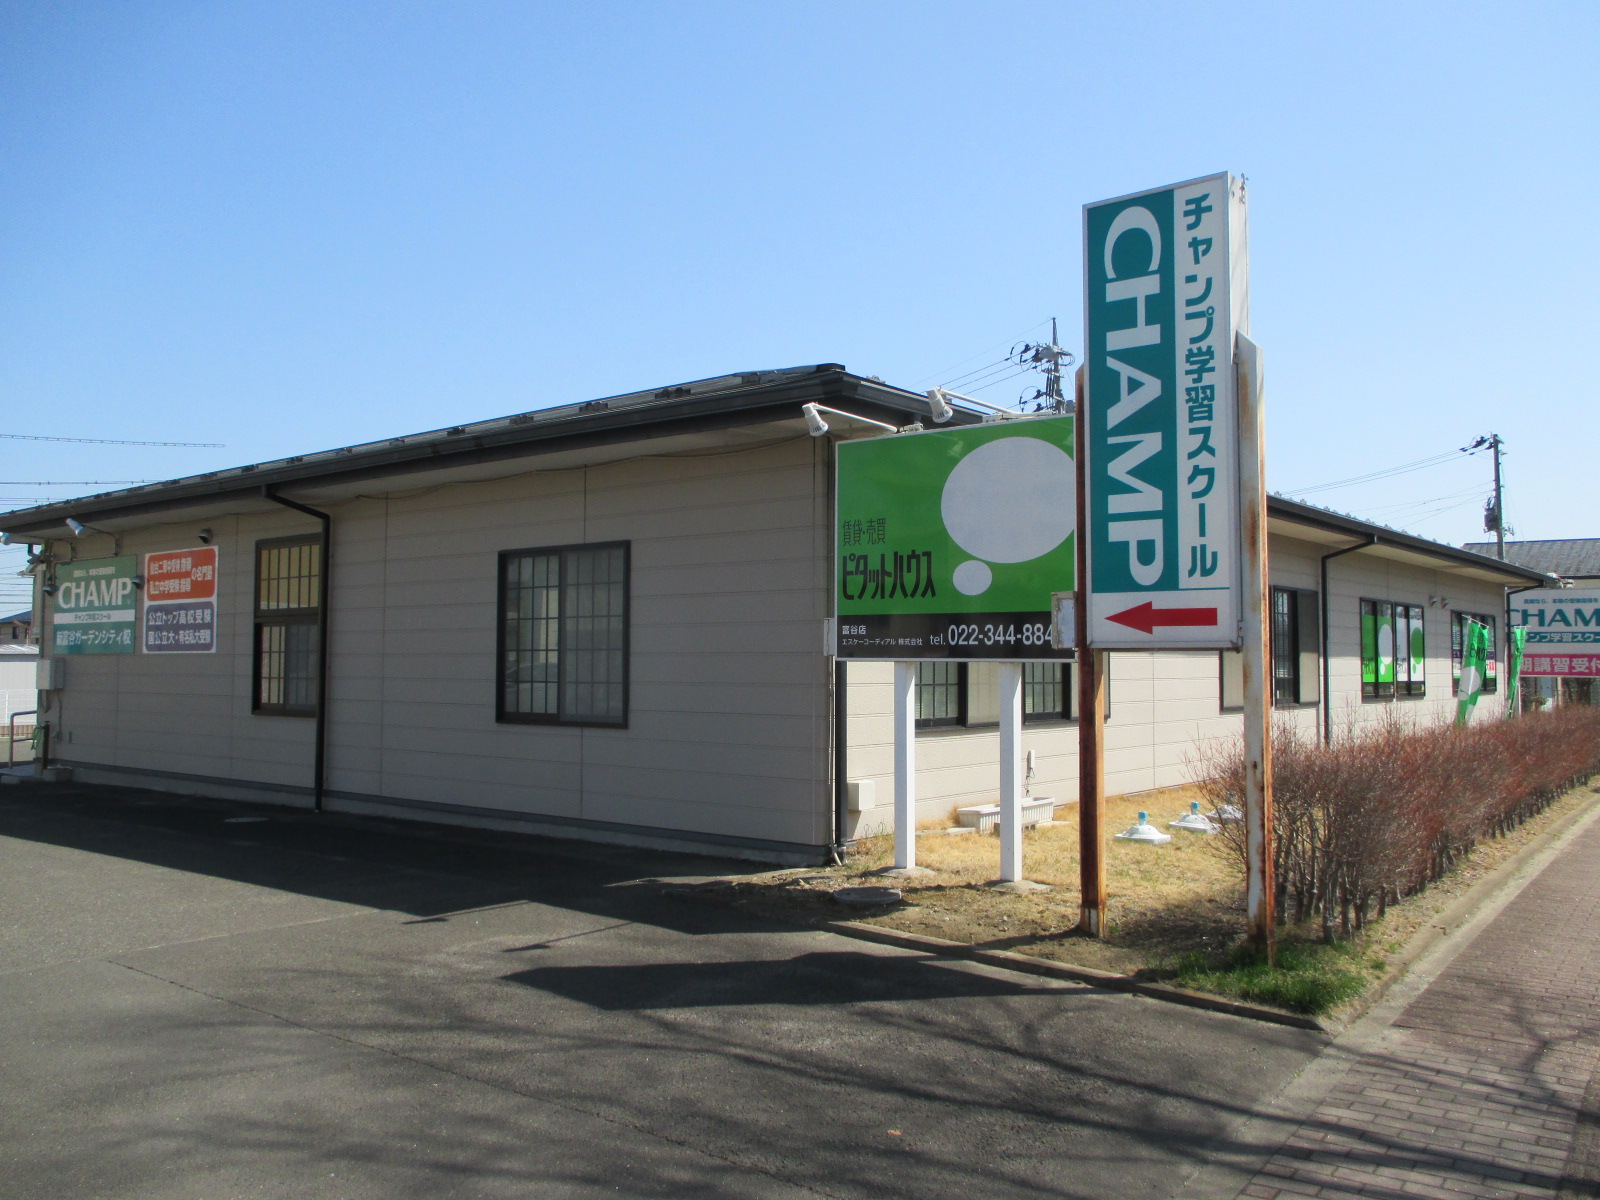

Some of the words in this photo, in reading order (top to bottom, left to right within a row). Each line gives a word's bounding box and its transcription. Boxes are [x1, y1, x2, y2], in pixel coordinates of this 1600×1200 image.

[1103, 206, 1164, 586] CHAMP
[1183, 192, 1218, 578] チャンプ学習スクール
[842, 518, 886, 546] 賃貸・売買
[842, 549, 936, 600] ピタットハウス
[58, 577, 132, 609] CHAMP
[148, 608, 212, 626] 公立トップ高校受験
[842, 625, 867, 635] 富谷店
[842, 638, 897, 646] エスケーコーディアル
[898, 638, 923, 646] 株式会社
[929, 634, 946, 645] tel.
